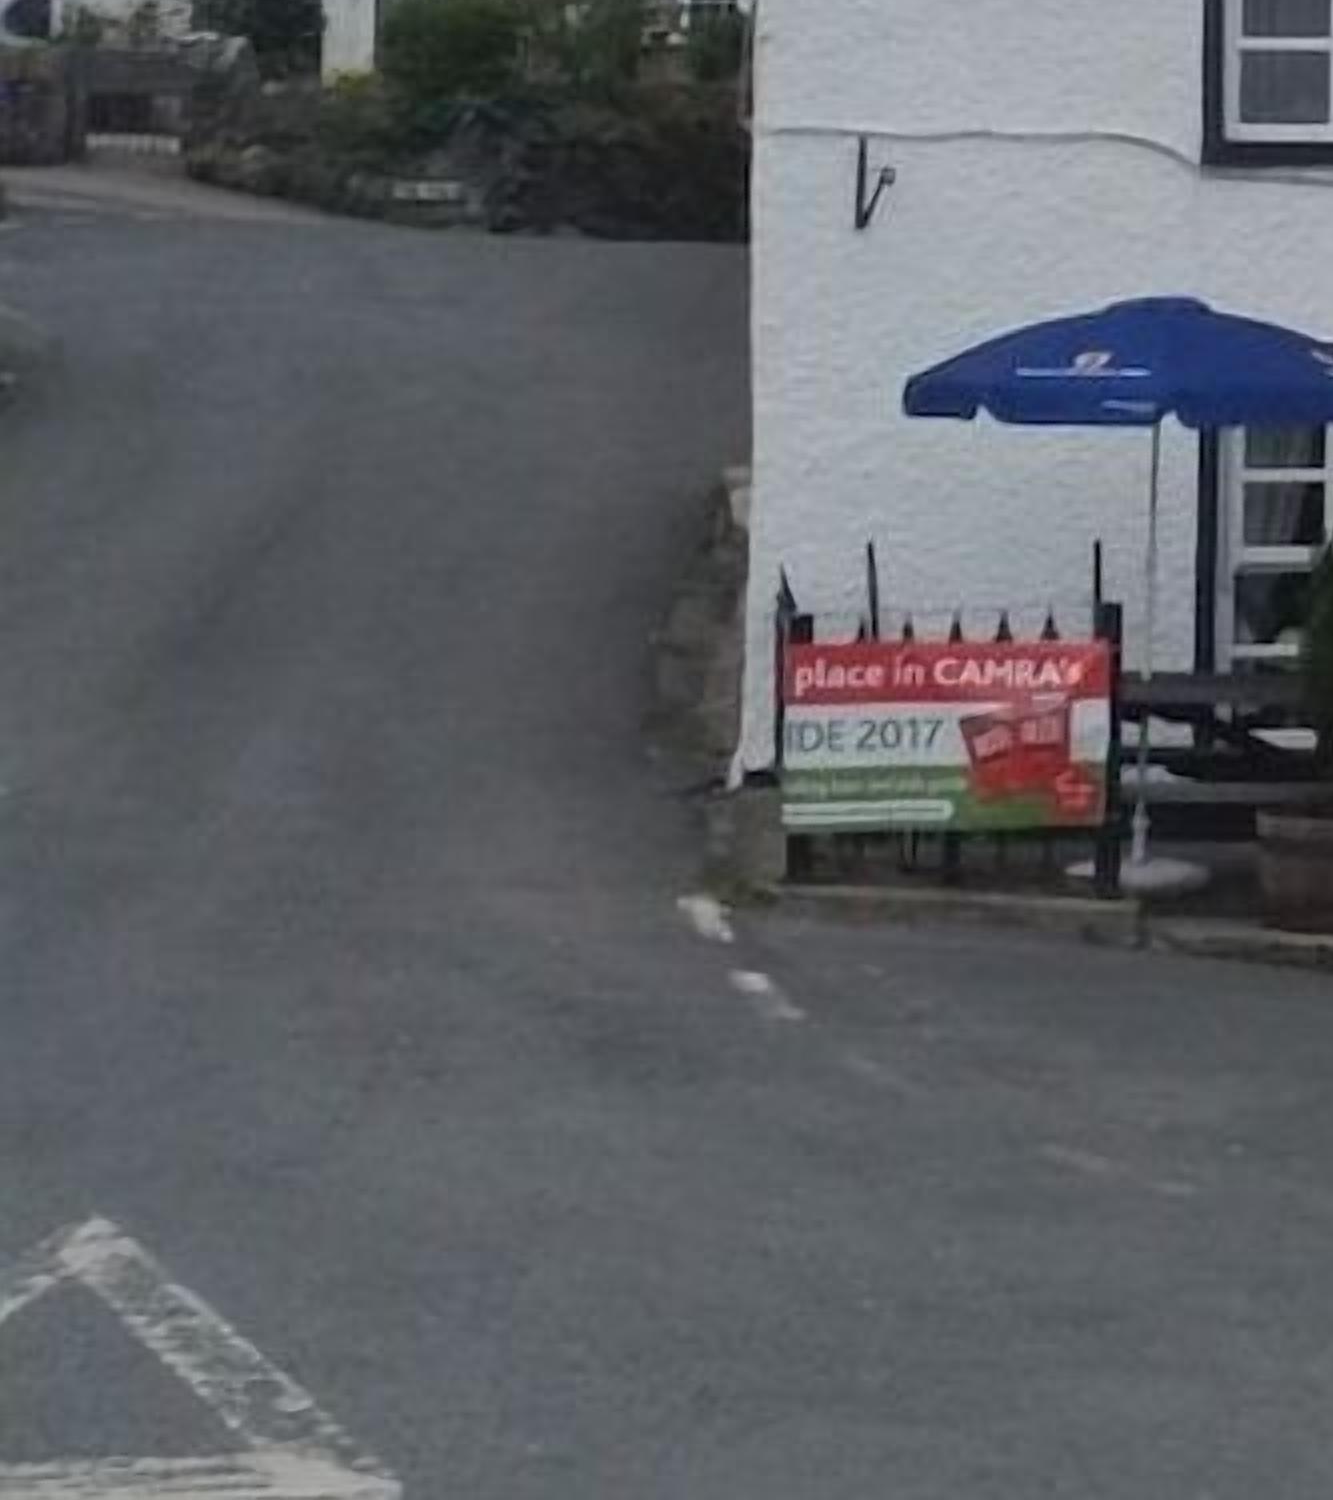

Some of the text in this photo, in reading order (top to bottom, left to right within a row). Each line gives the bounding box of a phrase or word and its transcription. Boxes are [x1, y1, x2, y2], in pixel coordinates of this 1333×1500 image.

[794, 656, 885, 697] place
[894, 654, 925, 686] in
[856, 717, 945, 750] 2017
